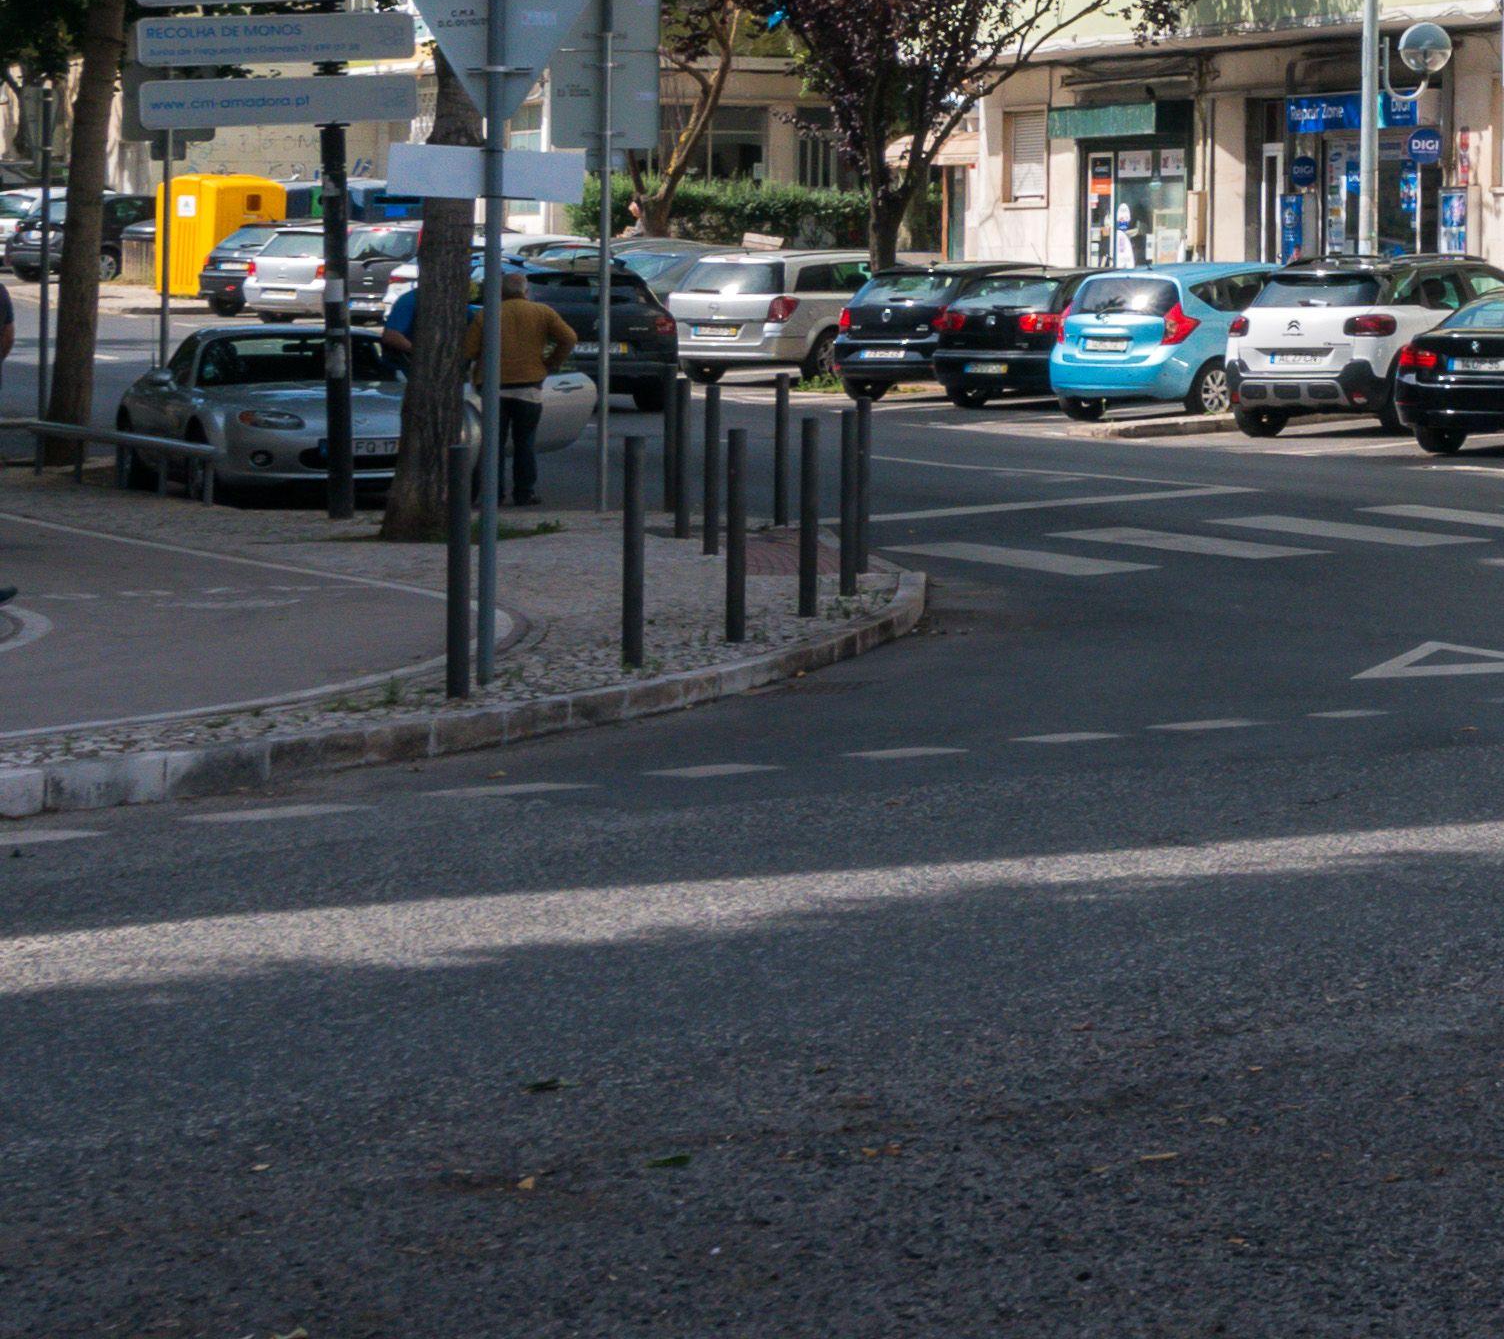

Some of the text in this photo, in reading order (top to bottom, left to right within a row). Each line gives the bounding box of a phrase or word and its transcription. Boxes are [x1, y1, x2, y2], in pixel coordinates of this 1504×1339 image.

[146, 24, 302, 39] RECOLHA DE MONOS
[150, 94, 311, 110] www.cm-amadora.pt
[1321, 103, 1345, 120] Zone
[1411, 139, 1440, 151] DIGI
[1293, 166, 1314, 176] DIGI
